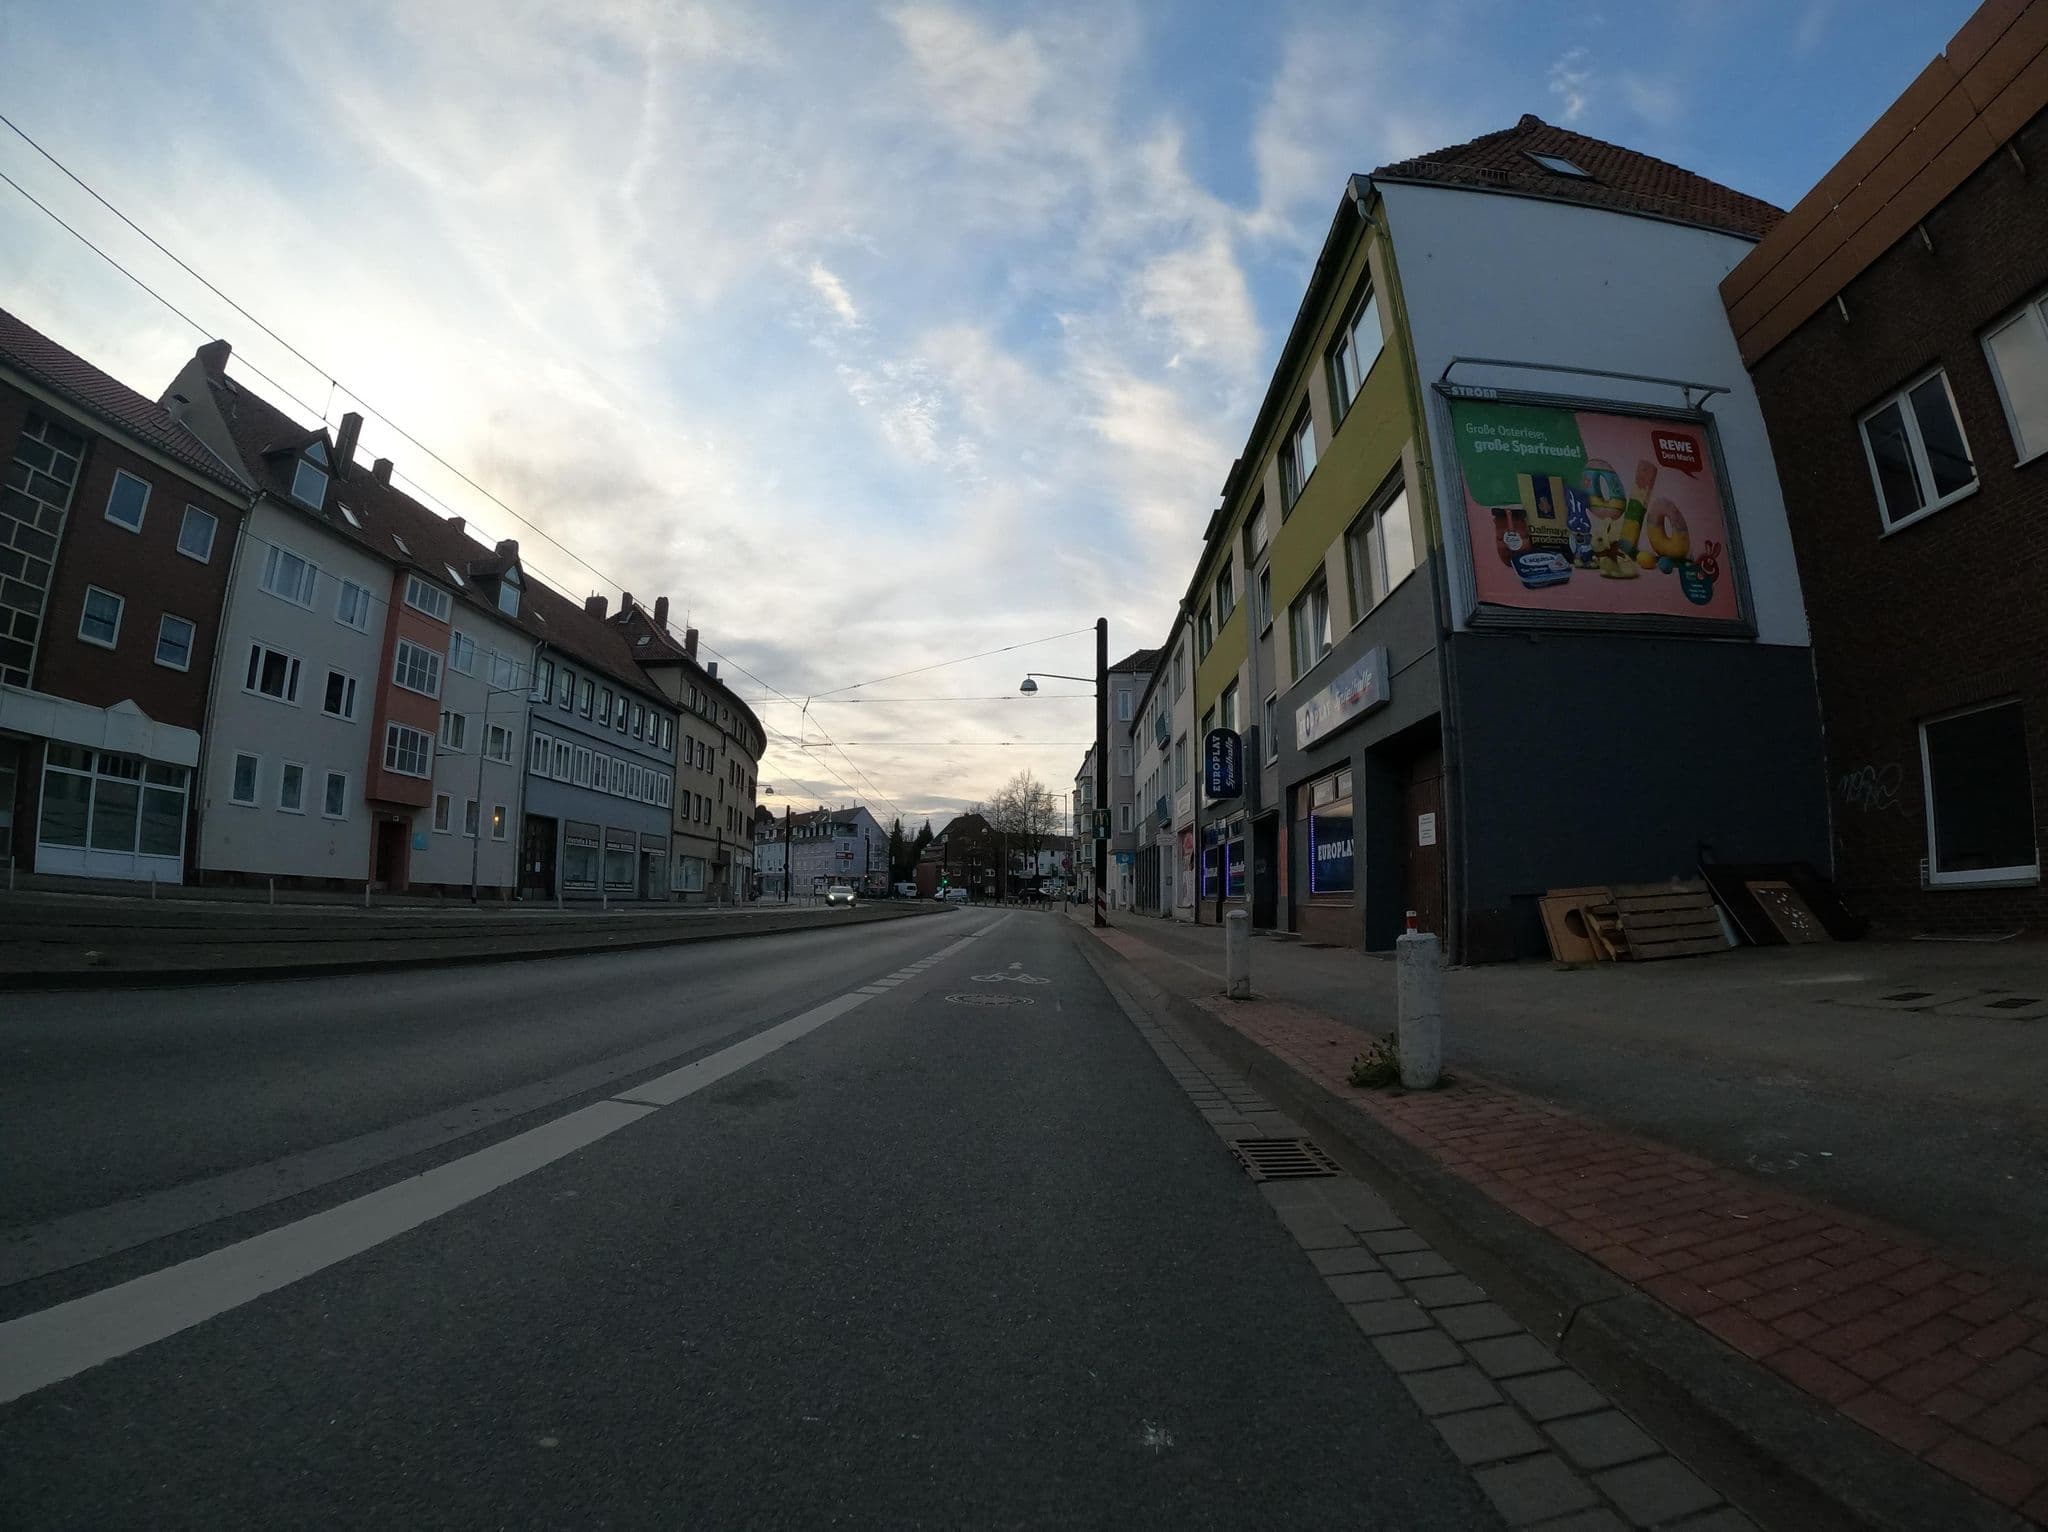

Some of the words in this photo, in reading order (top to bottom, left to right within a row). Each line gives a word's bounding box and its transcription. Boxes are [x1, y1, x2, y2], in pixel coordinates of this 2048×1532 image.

[1466, 423, 1496, 435] Große
[1498, 425, 1548, 441] Osterfeier,
[1475, 439, 1510, 453] große
[1512, 441, 1582, 458] Sparfreude!
[1658, 438, 1693, 453] REWE
[1531, 536, 1569, 545] prodomo
[1212, 735, 1221, 792] EUROPLAY
[1225, 736, 1236, 789] Spielhalle
